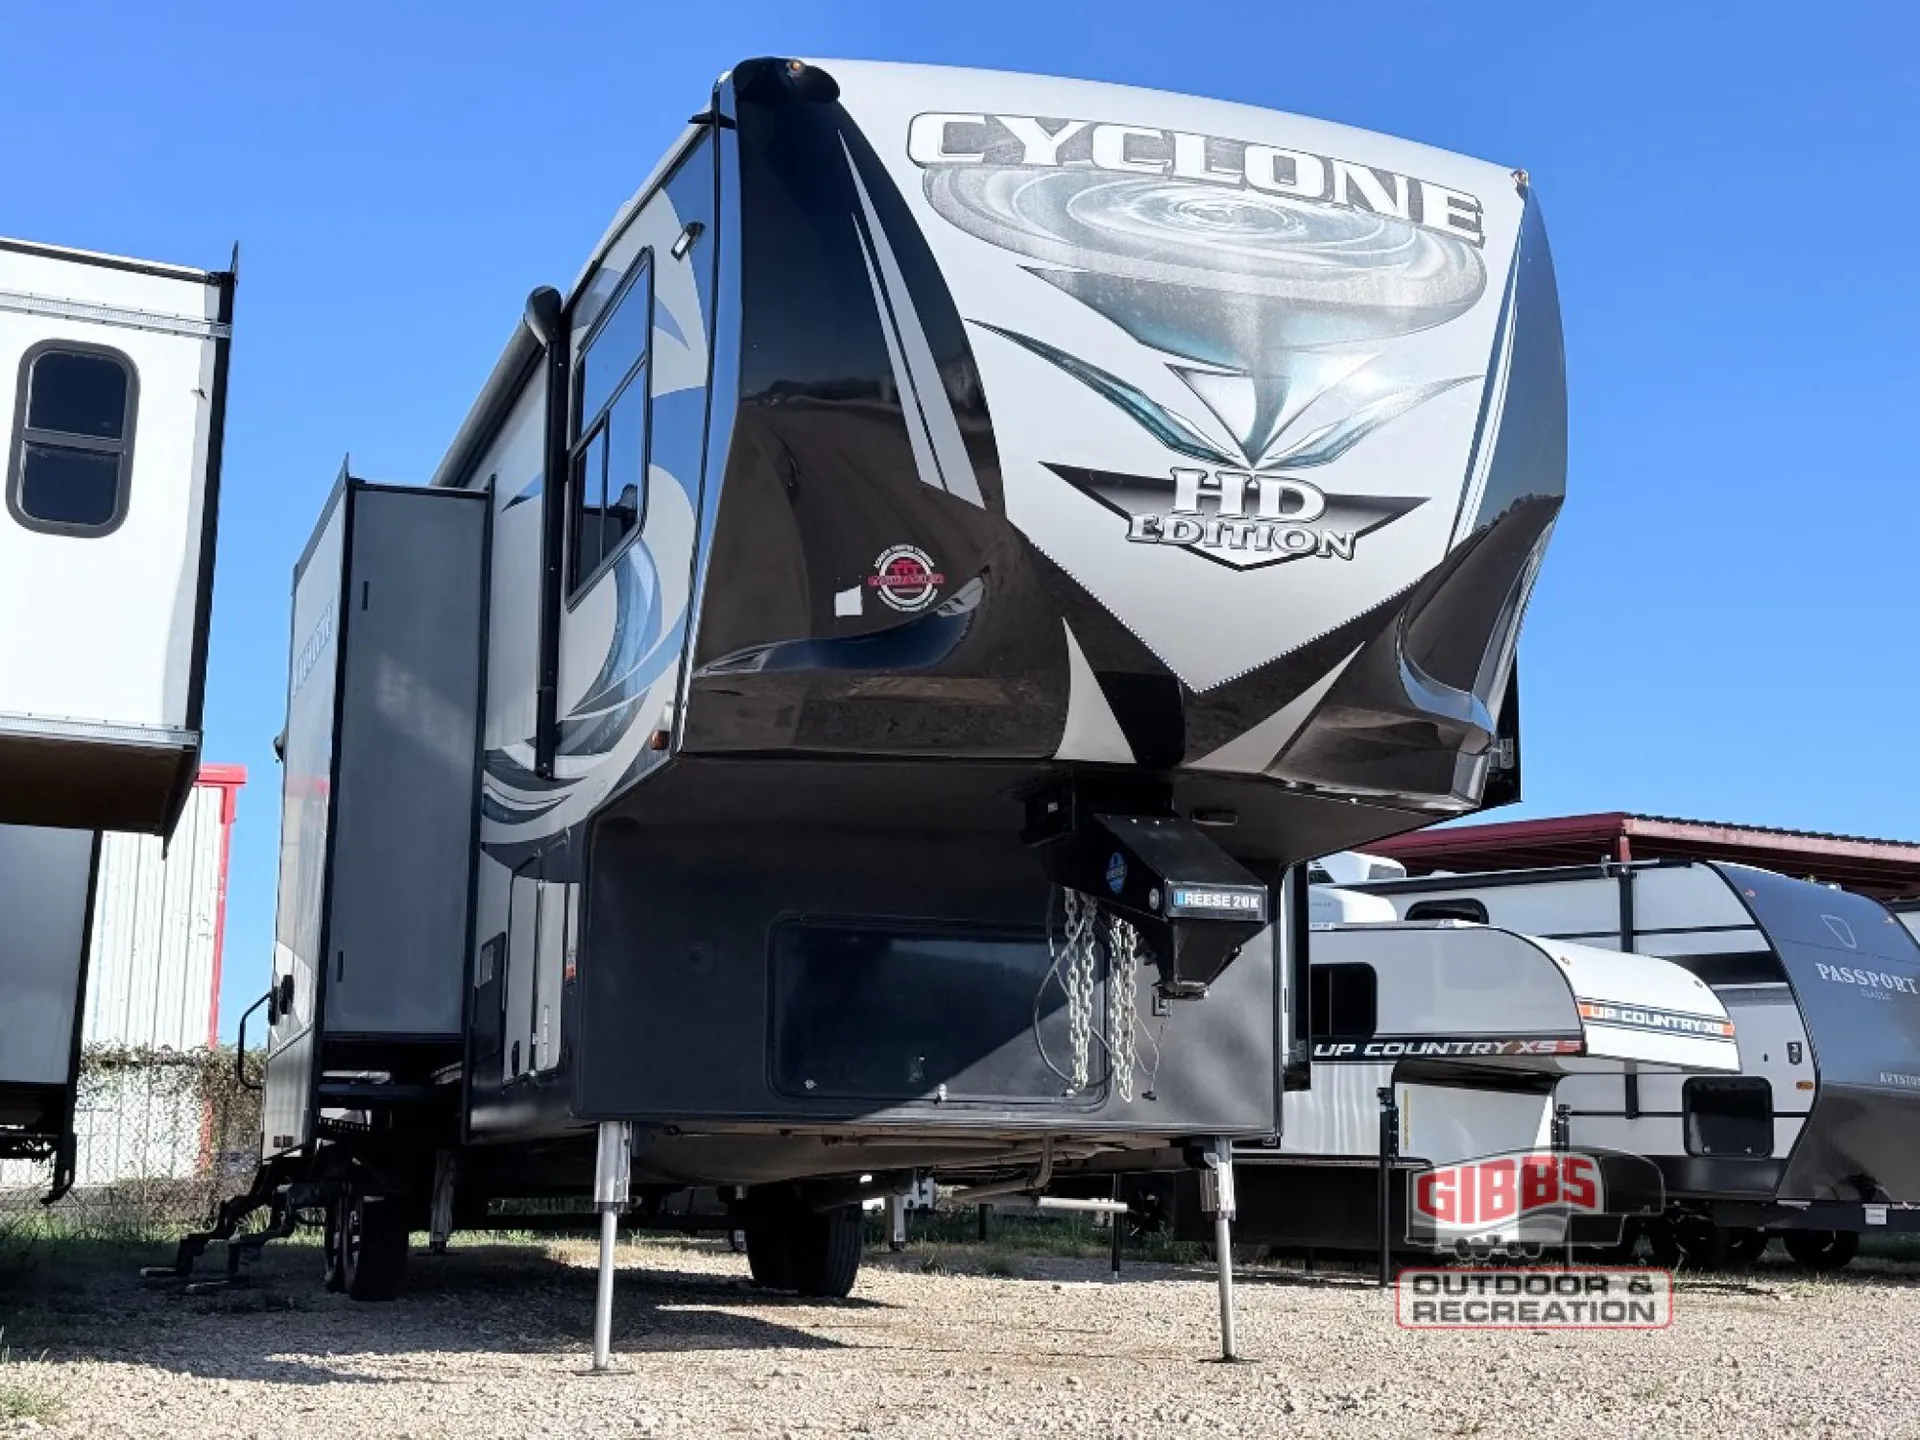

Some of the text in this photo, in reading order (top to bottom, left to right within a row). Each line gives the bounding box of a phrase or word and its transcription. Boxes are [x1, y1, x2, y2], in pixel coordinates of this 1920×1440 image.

[907, 112, 1486, 248] CYCLONE
[1170, 466, 1327, 523] HD
[1127, 512, 1356, 561] EDITION
[1184, 892, 1261, 909] REESE 20K
[1814, 961, 1919, 995] PASSPORT
[1591, 1005, 1617, 1019] UP
[1621, 1009, 1702, 1033] COUNTRY
[1313, 1043, 1357, 1057] UP
[1362, 1041, 1513, 1056] COUNTRY
